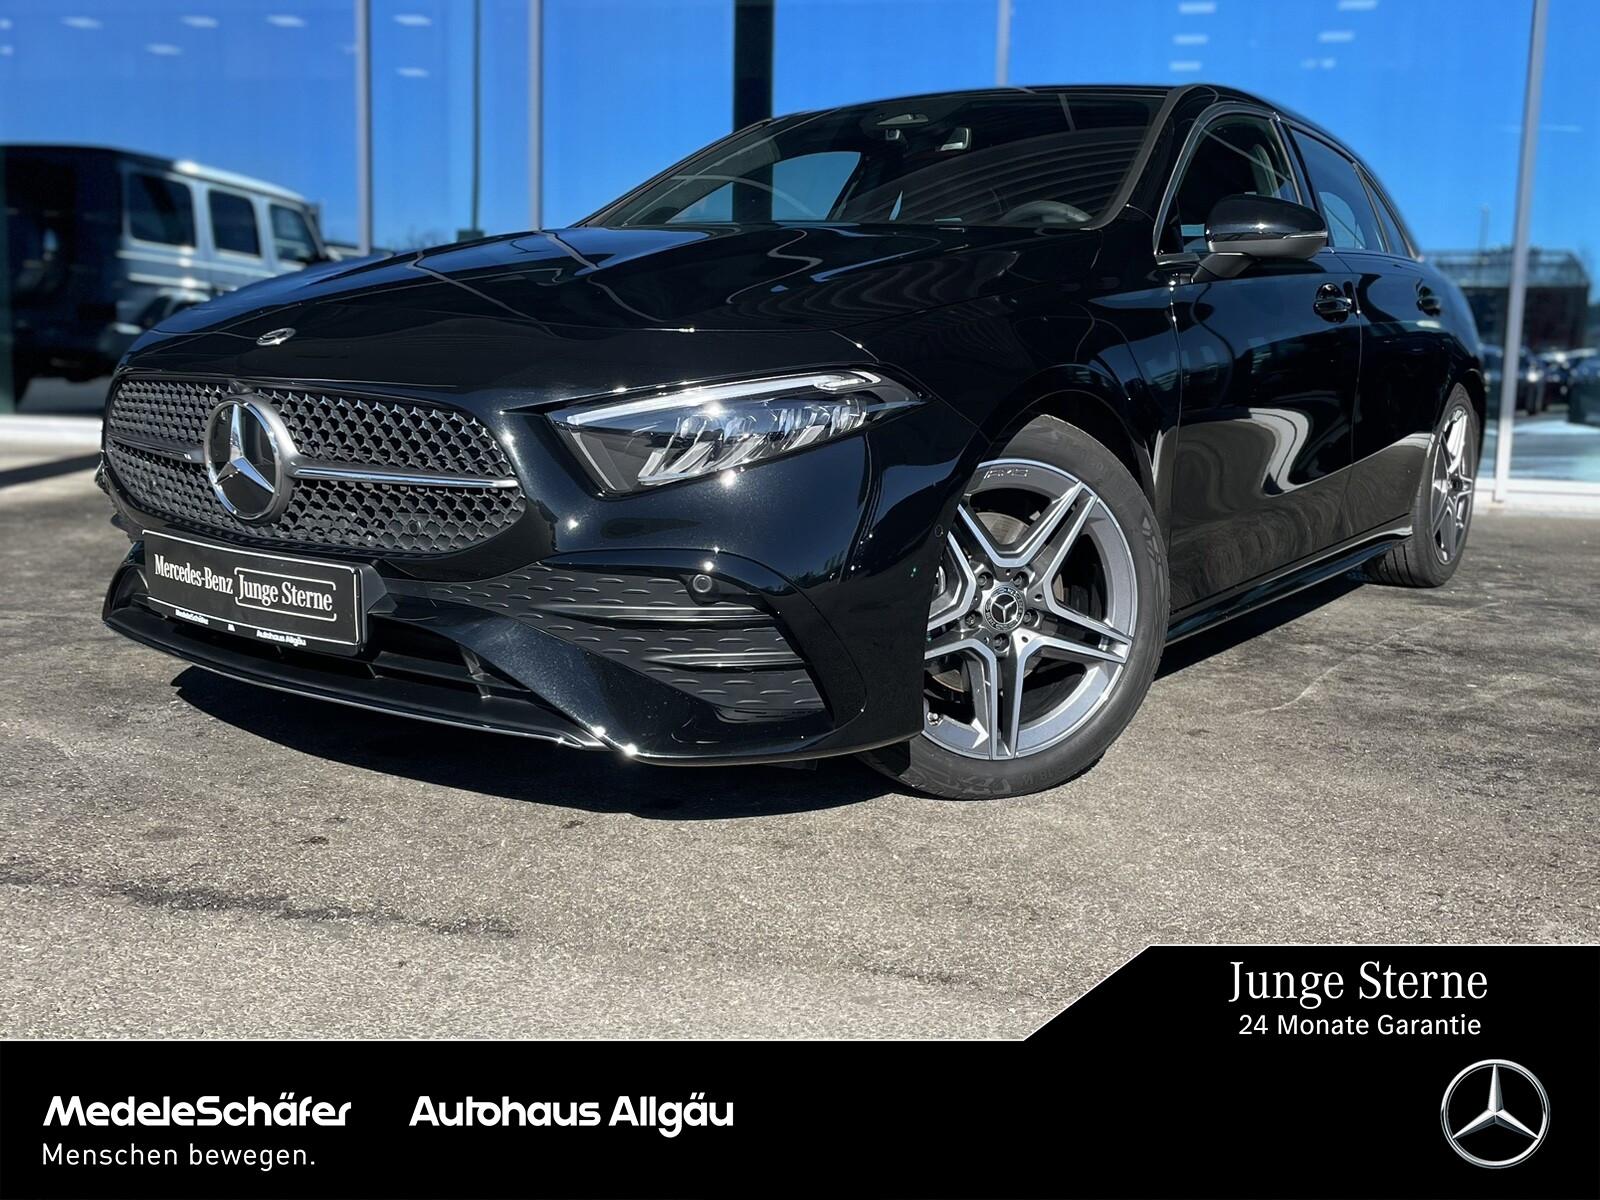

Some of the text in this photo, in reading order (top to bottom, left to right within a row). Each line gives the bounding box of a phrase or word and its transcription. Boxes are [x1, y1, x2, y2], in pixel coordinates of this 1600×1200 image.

[154, 553, 334, 612] Mercedes-Benz Junge Sterne
